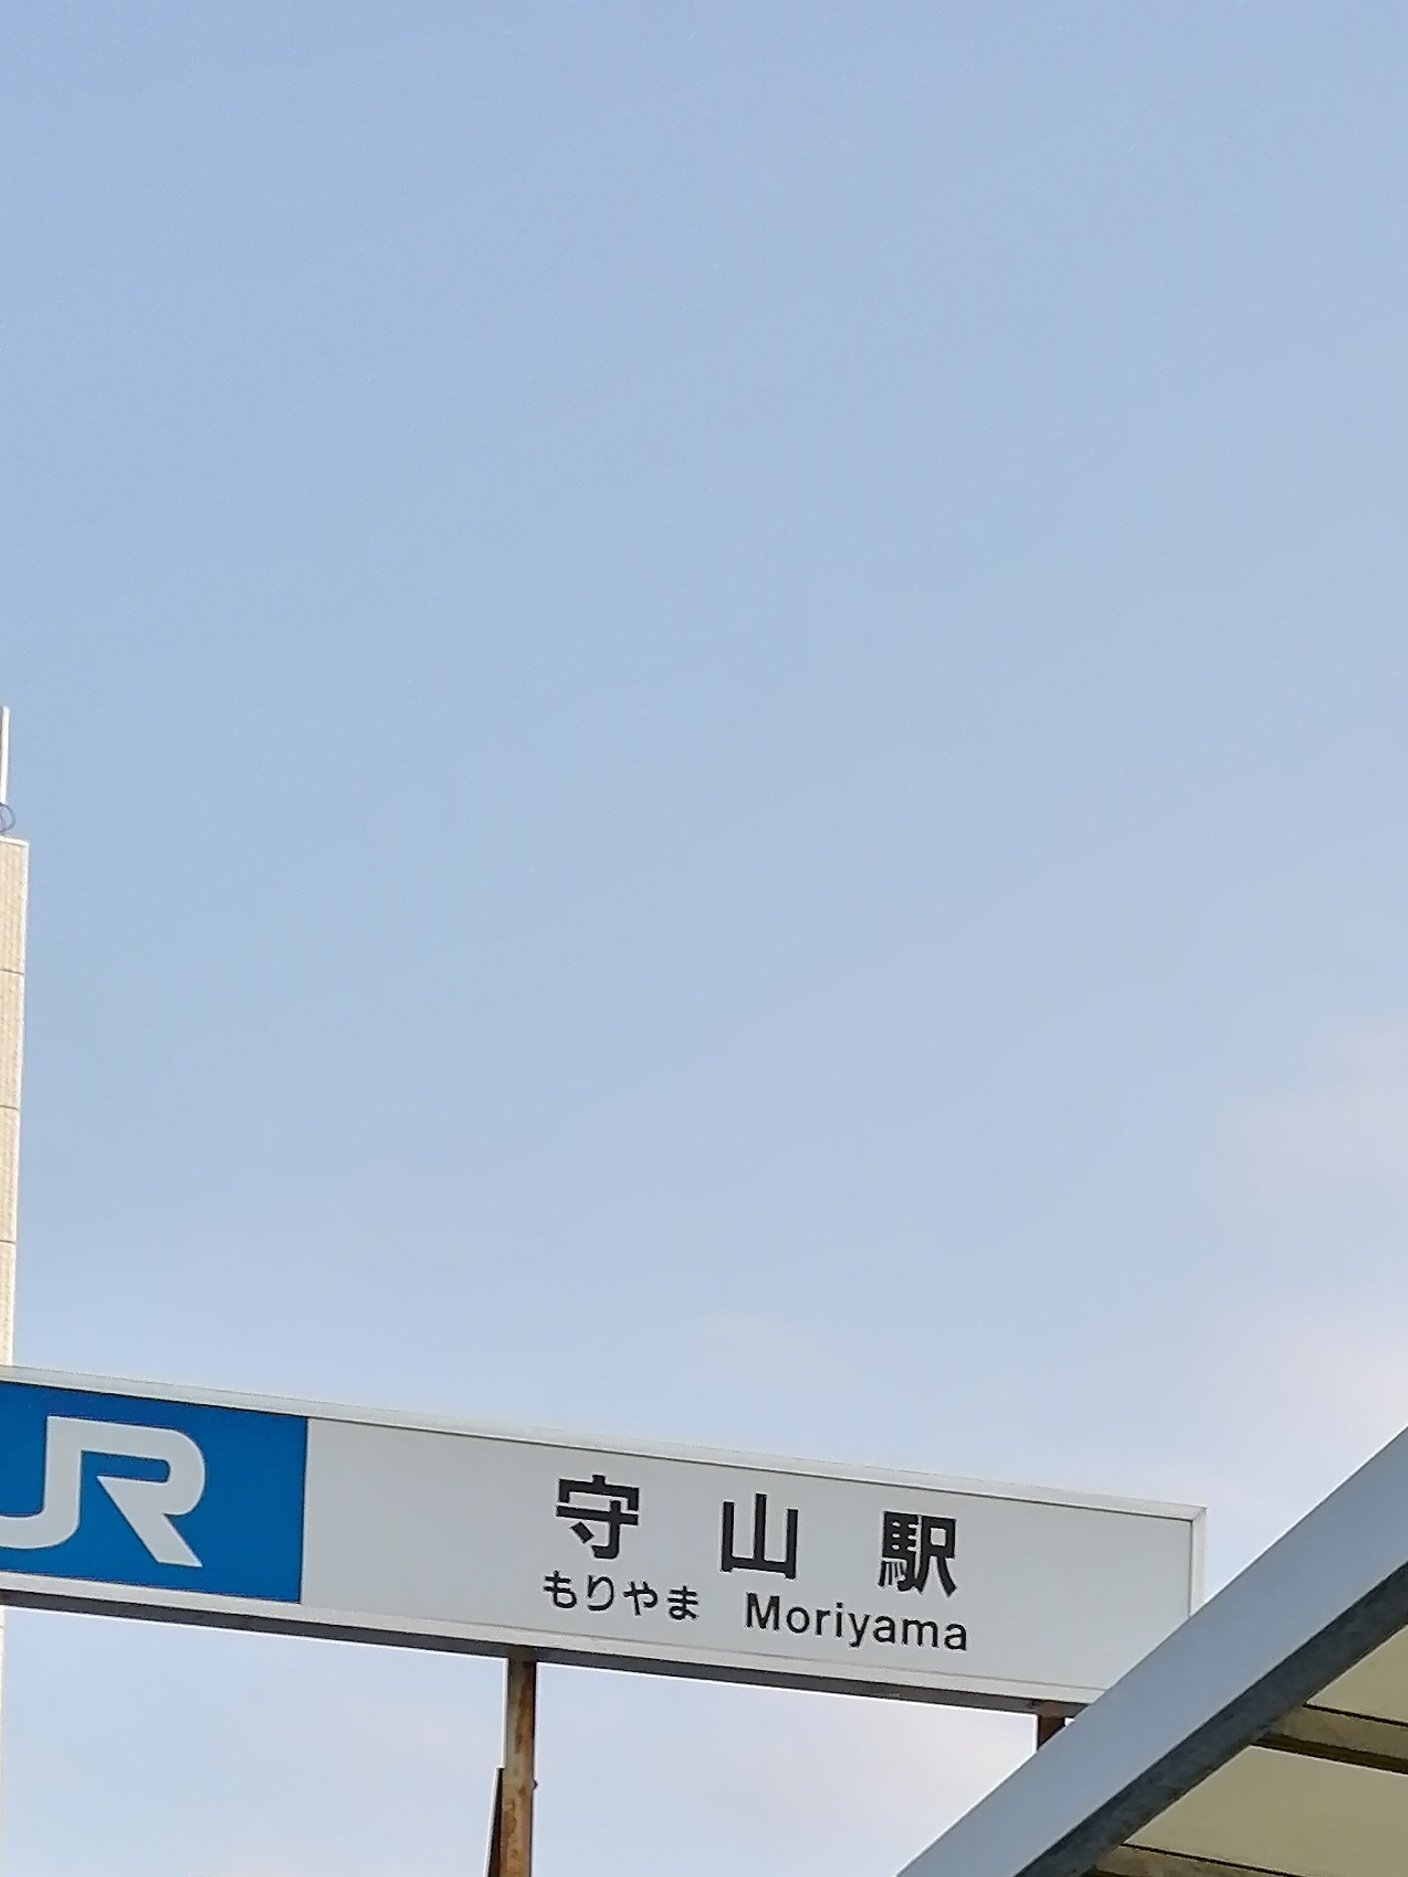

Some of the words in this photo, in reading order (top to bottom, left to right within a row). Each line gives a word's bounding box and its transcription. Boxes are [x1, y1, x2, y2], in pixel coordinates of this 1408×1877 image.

[555, 1474, 957, 1598] 守山駅
[543, 1570, 699, 1622] もりやま
[745, 1592, 968, 1651] Moriyama
